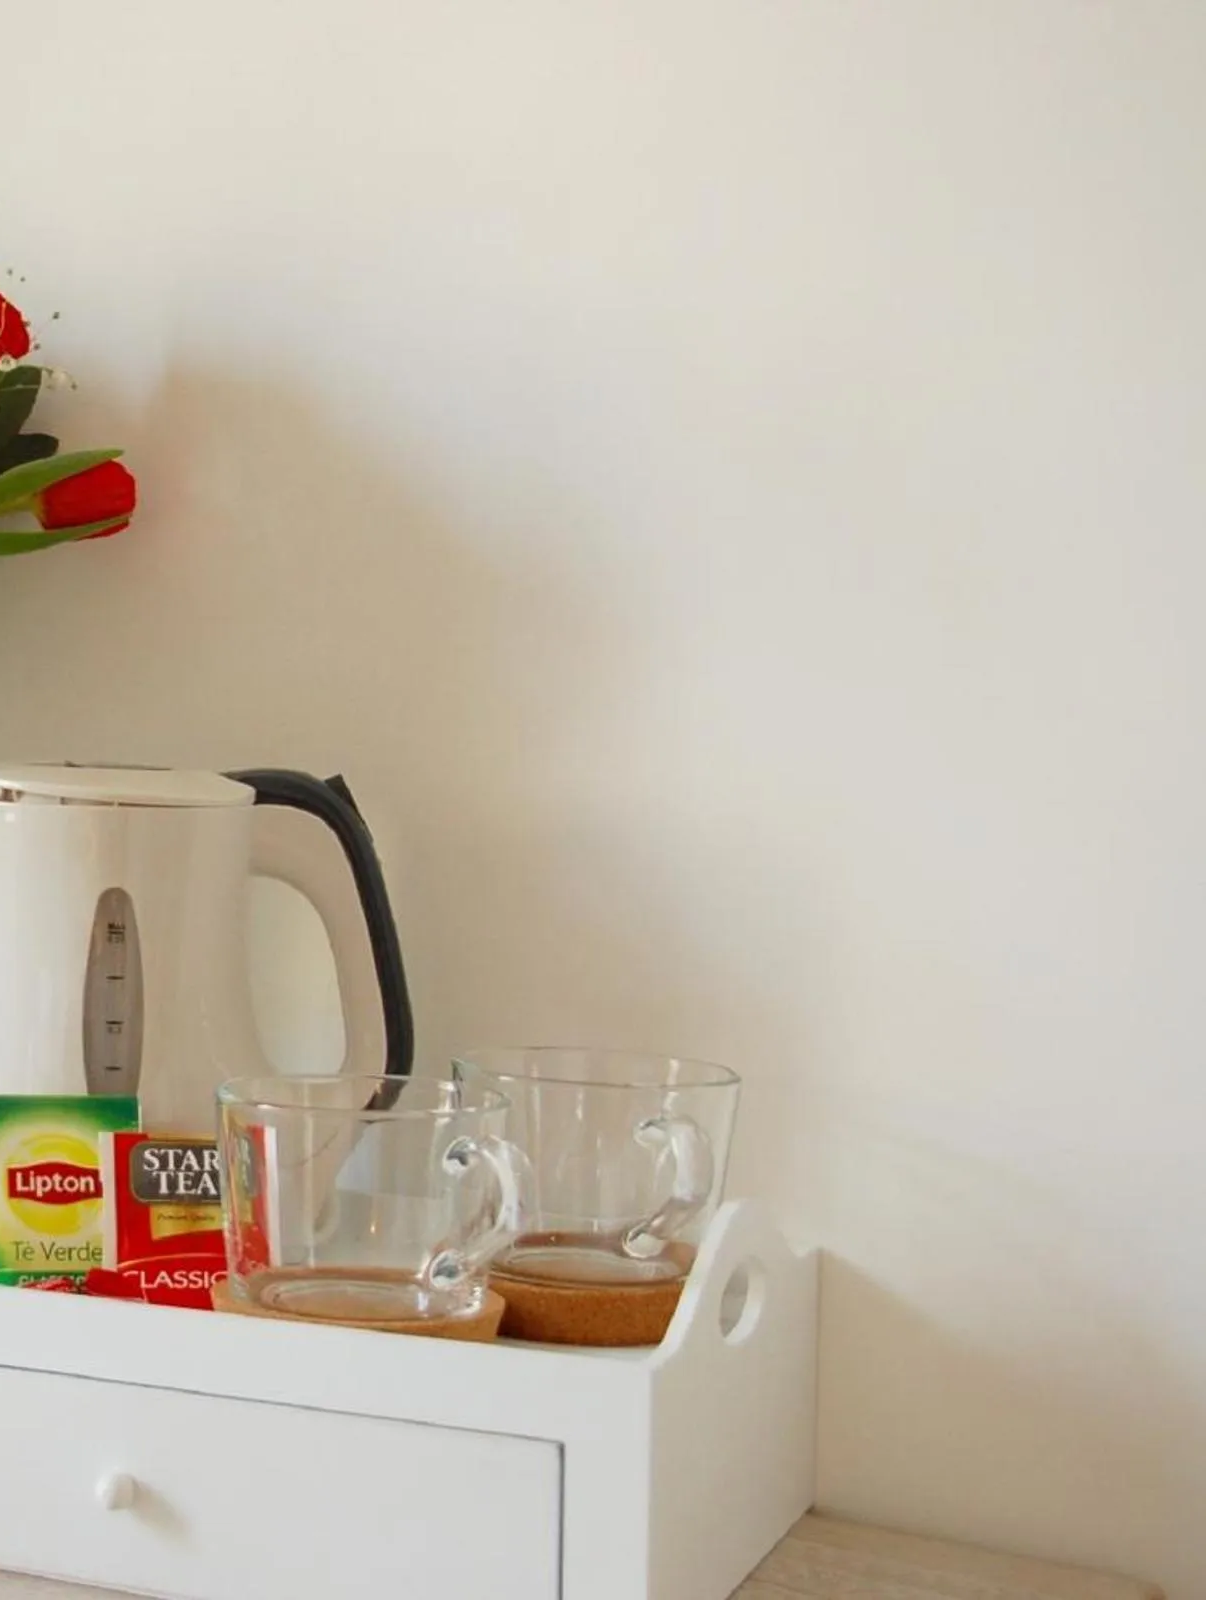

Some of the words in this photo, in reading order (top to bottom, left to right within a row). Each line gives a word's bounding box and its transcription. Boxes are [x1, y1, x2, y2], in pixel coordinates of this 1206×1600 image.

[143, 1148, 221, 1171] STAR
[16, 1170, 96, 1198] Lipton
[152, 1171, 218, 1195] TEA
[40, 1240, 103, 1262] Verde
